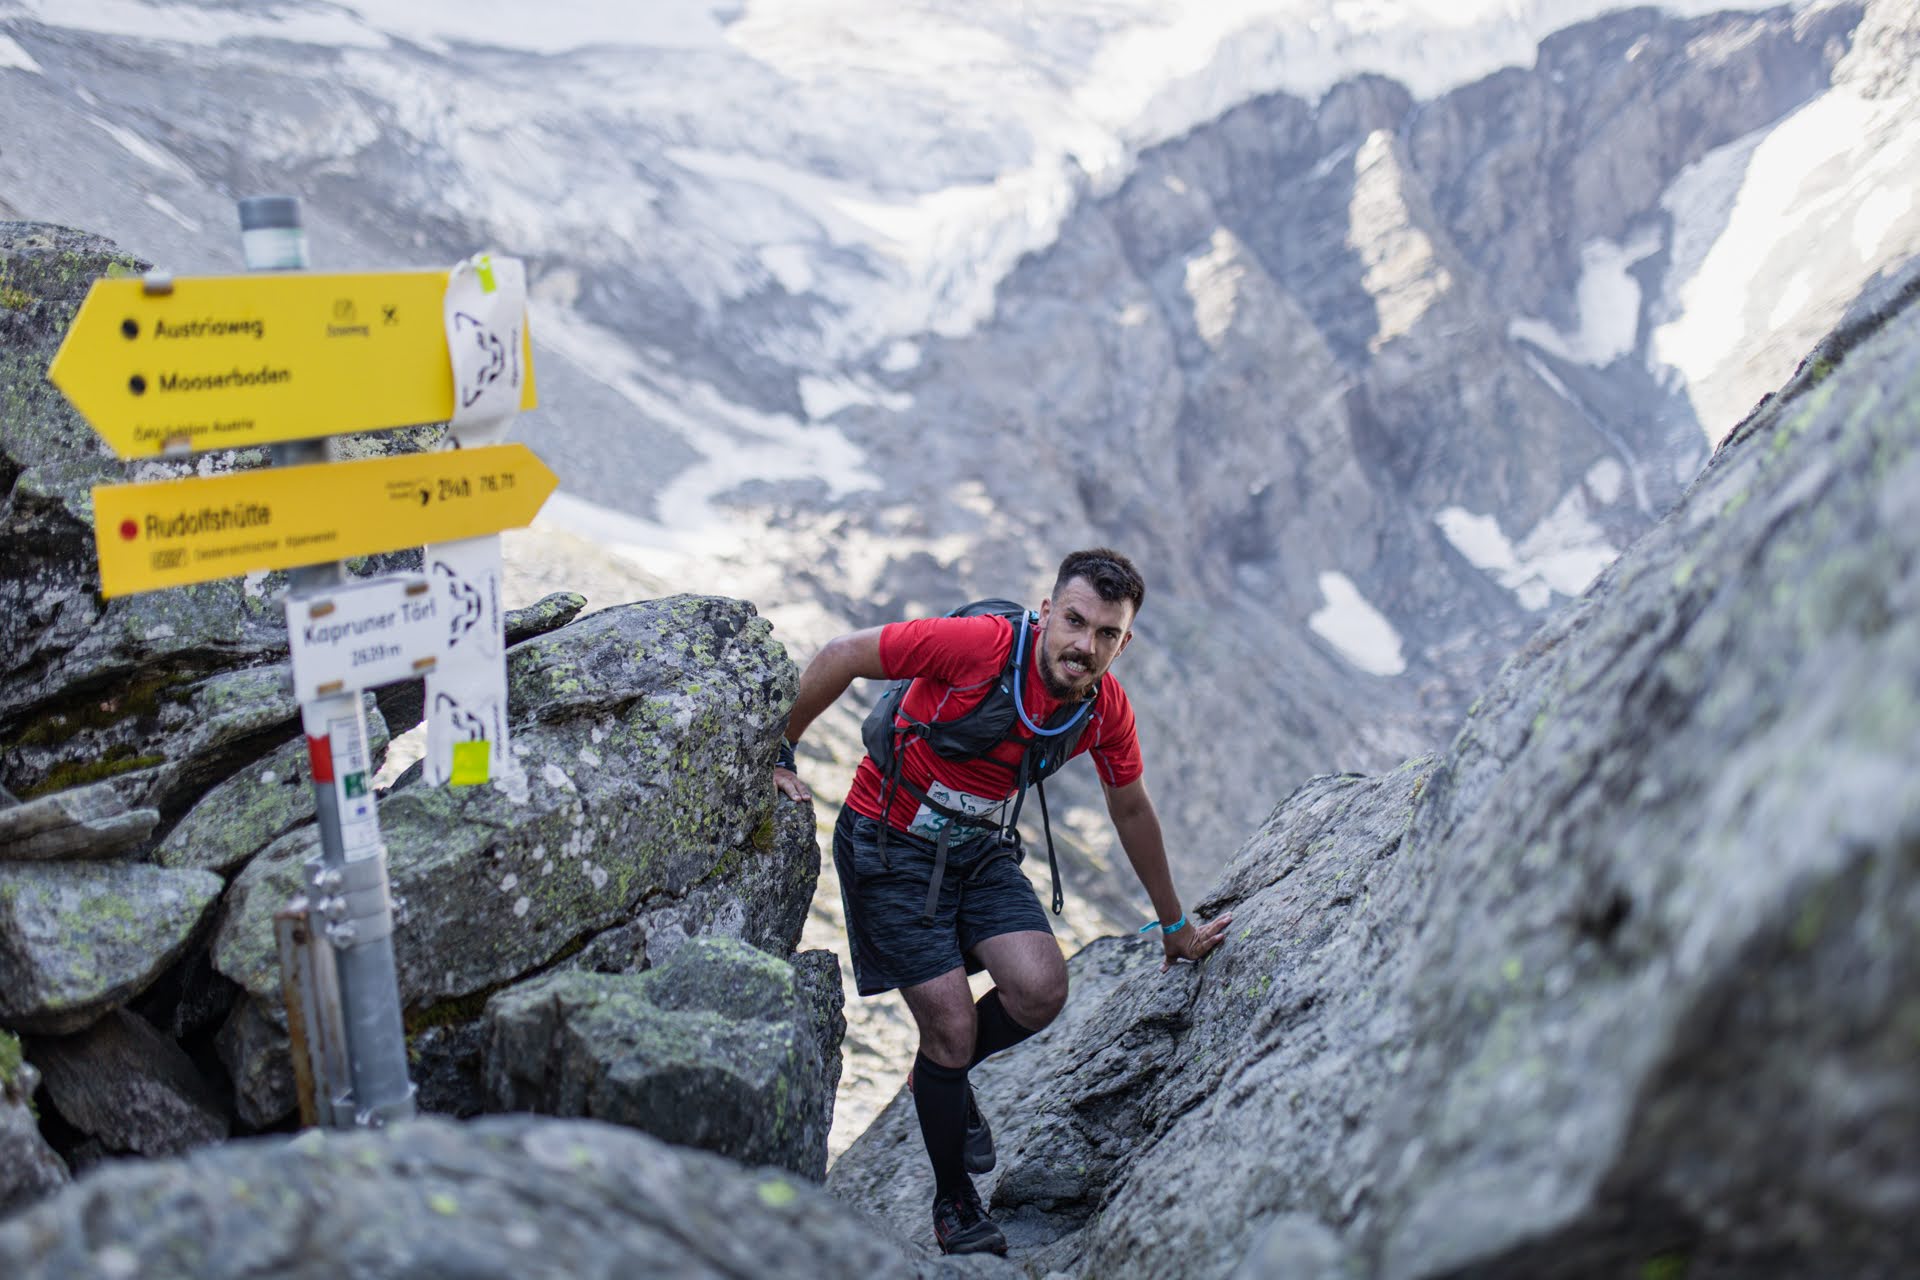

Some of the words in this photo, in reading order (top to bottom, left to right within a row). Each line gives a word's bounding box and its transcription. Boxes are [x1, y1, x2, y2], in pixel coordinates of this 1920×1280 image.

[154, 317, 265, 340] Austriaweg
[159, 366, 291, 393] Mooserboden
[145, 503, 271, 540] Rudolfshütte
[303, 611, 396, 645] Kapruner
[400, 599, 437, 624] Törl
